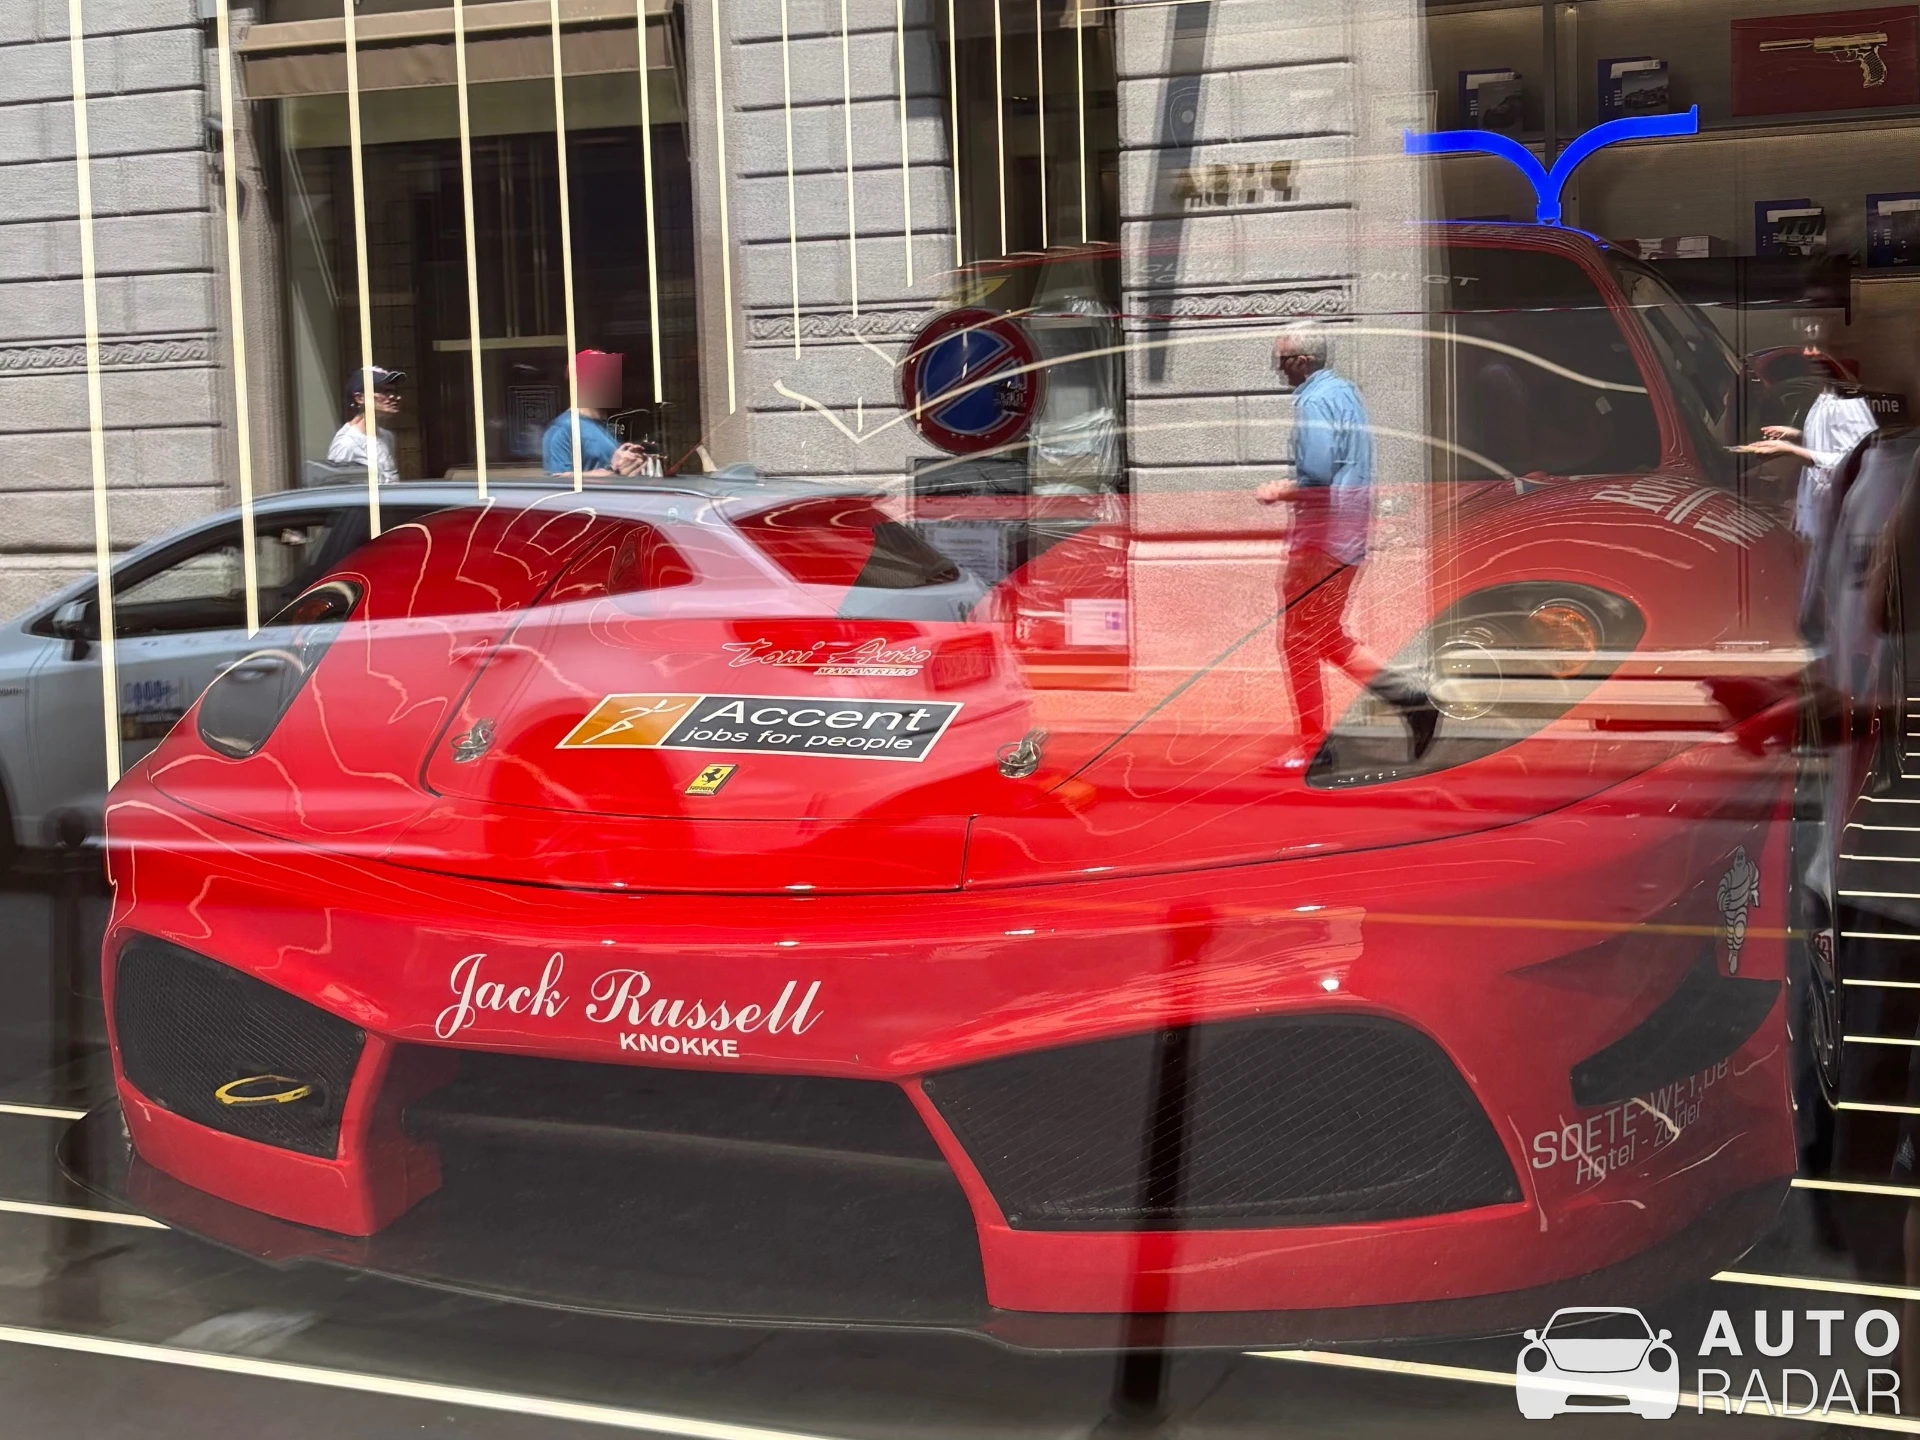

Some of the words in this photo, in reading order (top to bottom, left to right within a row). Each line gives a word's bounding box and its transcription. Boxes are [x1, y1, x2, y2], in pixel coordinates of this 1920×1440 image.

[827, 637, 932, 664] Auto
[700, 700, 930, 732] Accent
[680, 727, 749, 742] jobs
[757, 730, 802, 744] for
[804, 735, 914, 751] people
[435, 951, 570, 1039] Jack
[585, 968, 824, 1035] Russell
[620, 1032, 740, 1058] KNOKKE
[1576, 1132, 1636, 1185] Hotel
